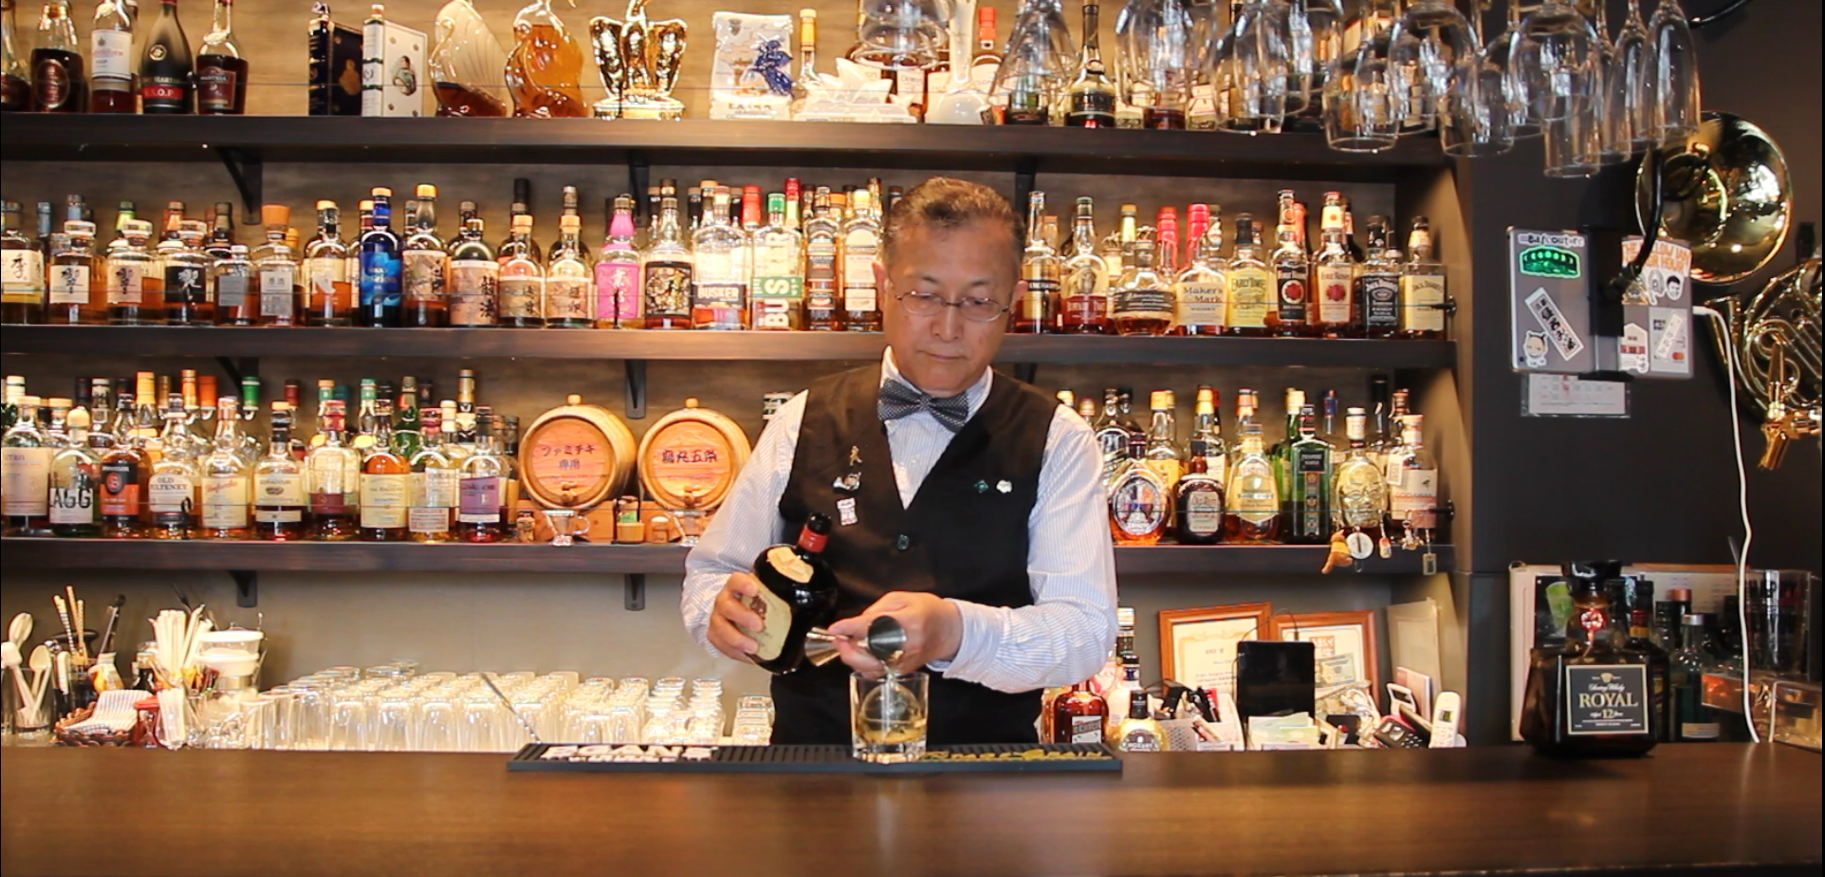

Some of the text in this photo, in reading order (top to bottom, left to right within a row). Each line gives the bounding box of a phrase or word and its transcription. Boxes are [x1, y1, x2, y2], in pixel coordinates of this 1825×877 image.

[763, 231, 790, 327] BUSR
[697, 286, 739, 301] BUSKER
[1183, 286, 1224, 295] Maker's
[1194, 295, 1222, 303] Mark
[542, 445, 595, 457] ファミチキ
[1579, 692, 1639, 708] ROYAL
[1602, 708, 1614, 719] 12
